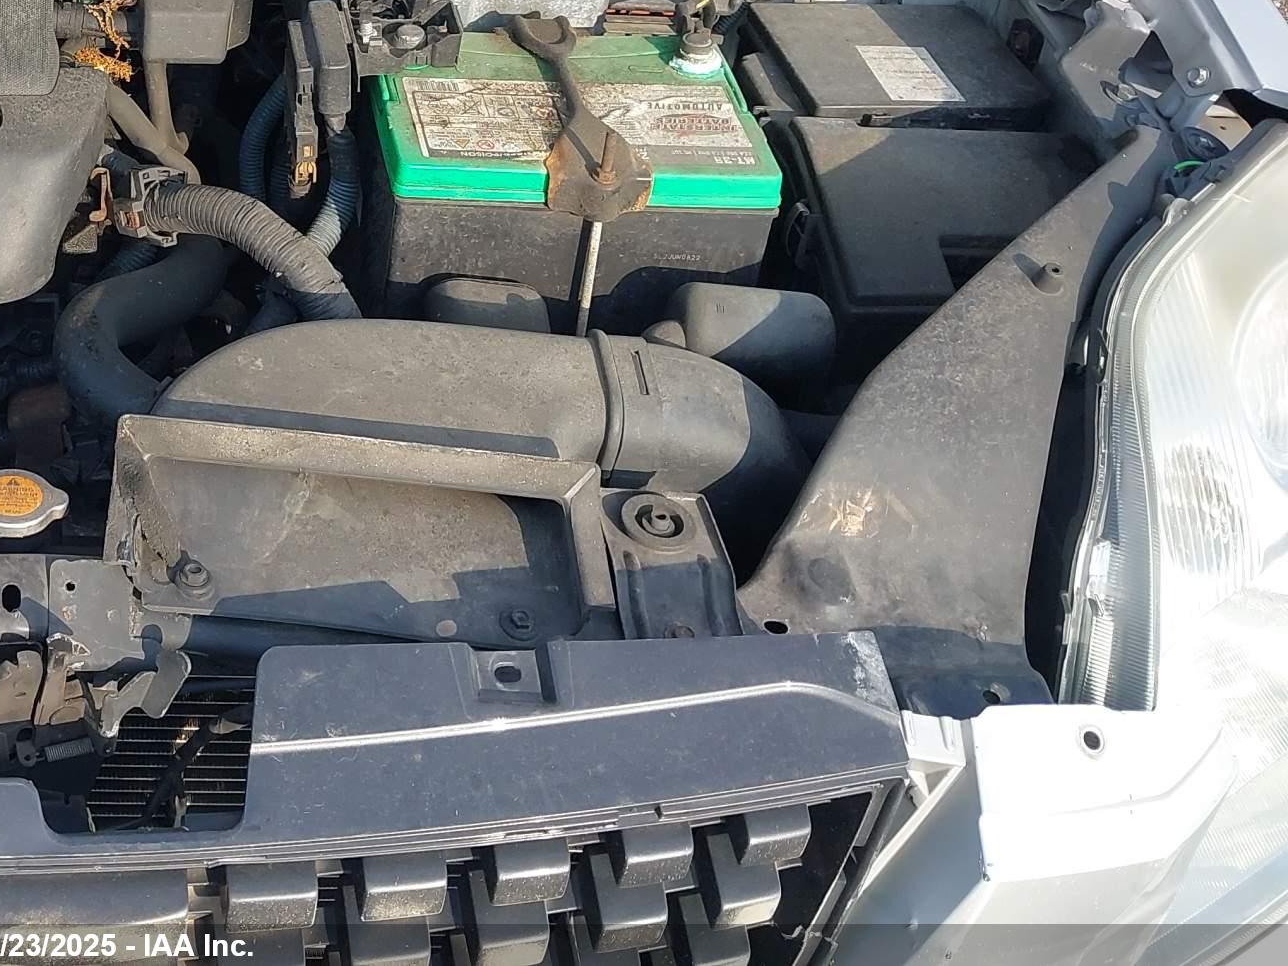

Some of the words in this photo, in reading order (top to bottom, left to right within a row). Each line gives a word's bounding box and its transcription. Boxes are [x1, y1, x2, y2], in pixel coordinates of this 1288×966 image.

[647, 101, 723, 112] AUTOMOTIVE
[654, 117, 732, 126] BATTERIES
[650, 122, 738, 132] INTERSTATE
